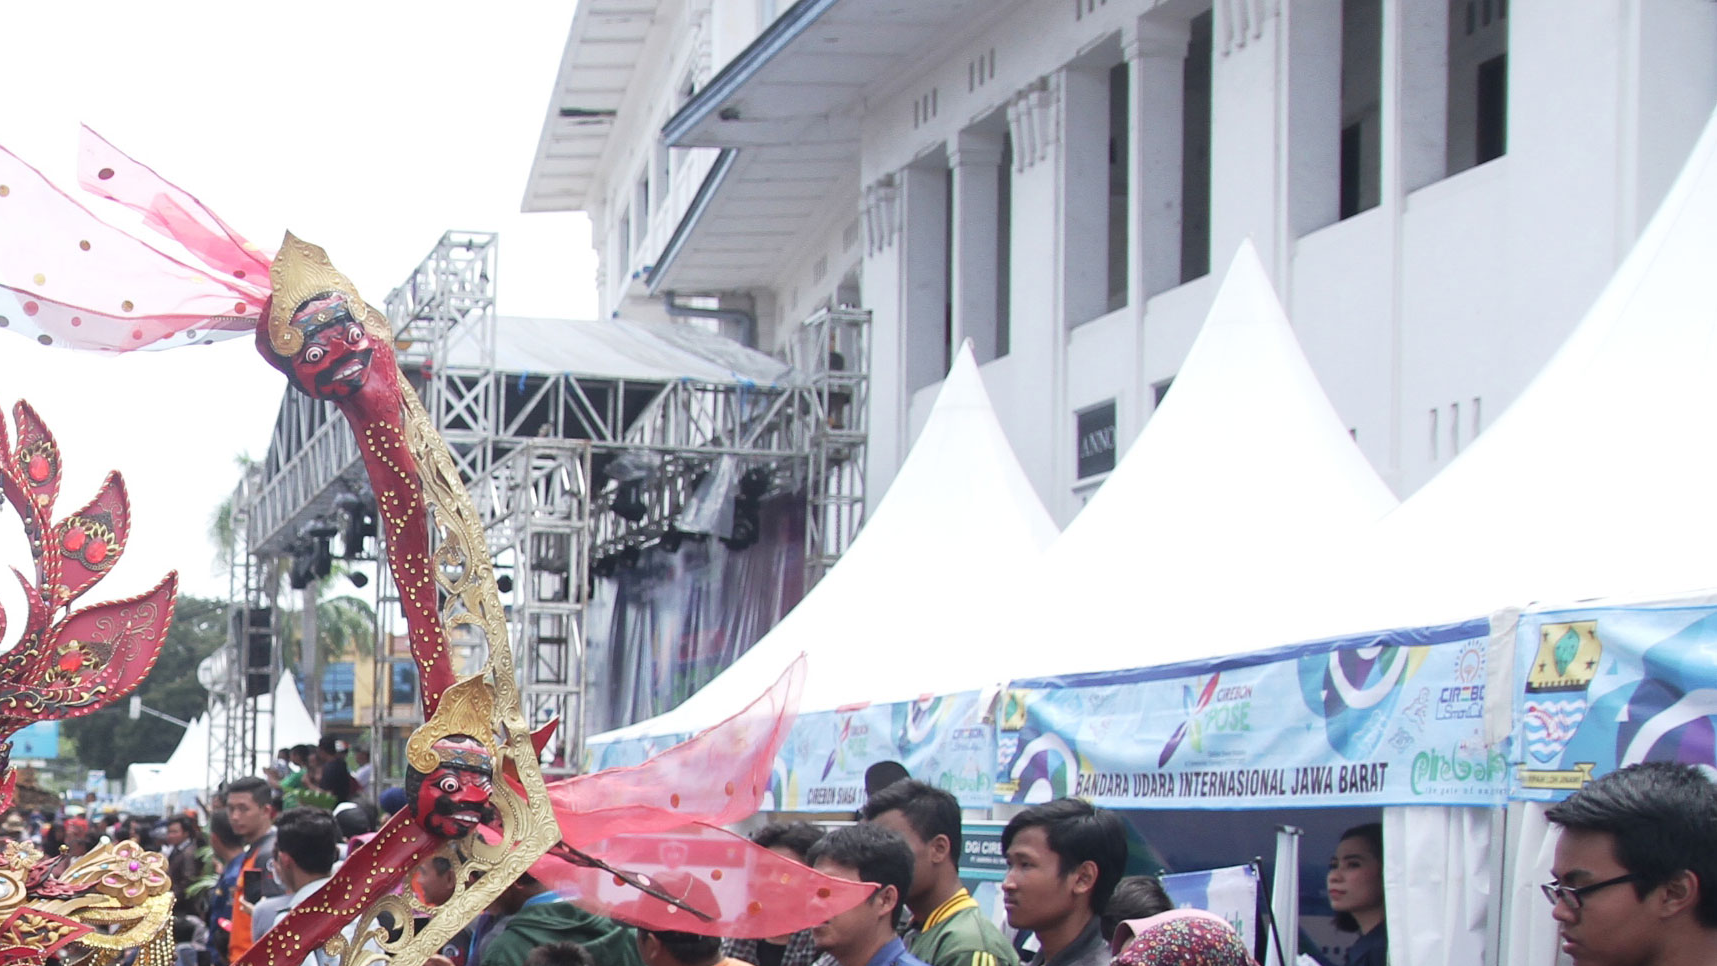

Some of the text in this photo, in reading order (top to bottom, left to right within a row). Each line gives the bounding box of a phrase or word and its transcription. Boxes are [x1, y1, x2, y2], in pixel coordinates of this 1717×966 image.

[1217, 686, 1252, 702] CIREBON
[1075, 761, 1389, 799] BANDARA UDARA INTERNASIONAL JAWA BARAT
